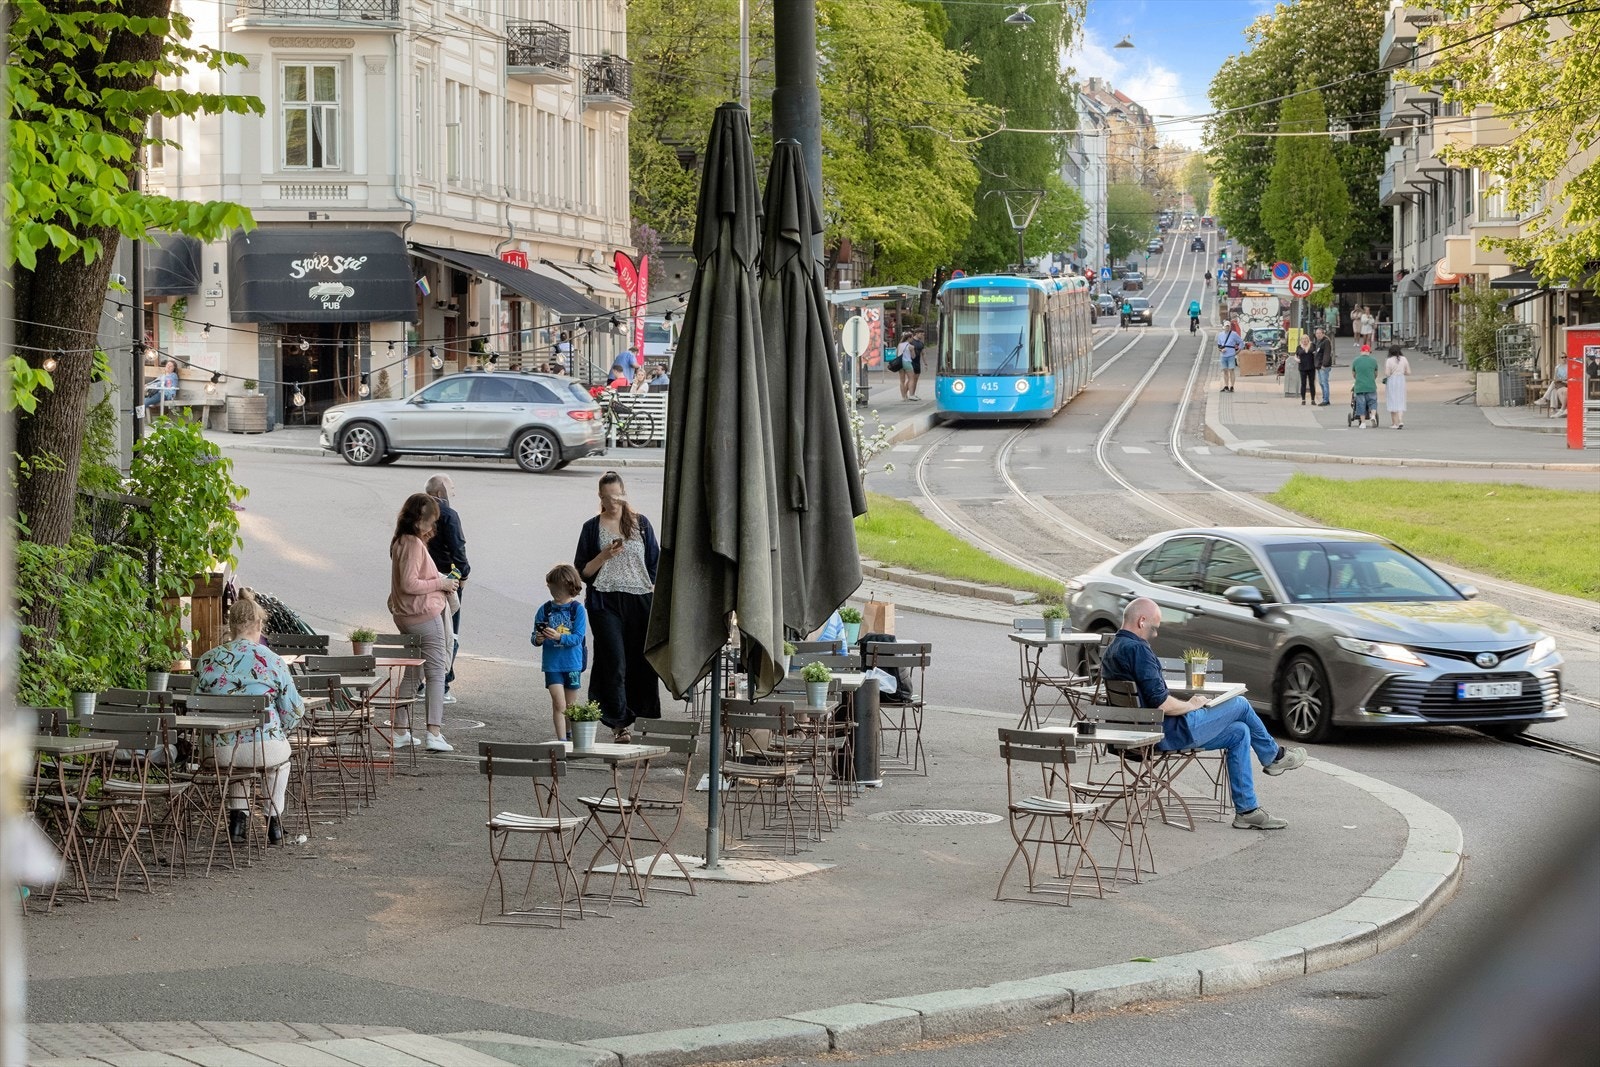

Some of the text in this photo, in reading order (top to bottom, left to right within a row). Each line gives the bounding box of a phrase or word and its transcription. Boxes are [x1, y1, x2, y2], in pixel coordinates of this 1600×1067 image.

[289, 254, 329, 278] Store
[1293, 279, 1310, 292] 40
[323, 302, 340, 310] PUB
[981, 382, 999, 391] 415
